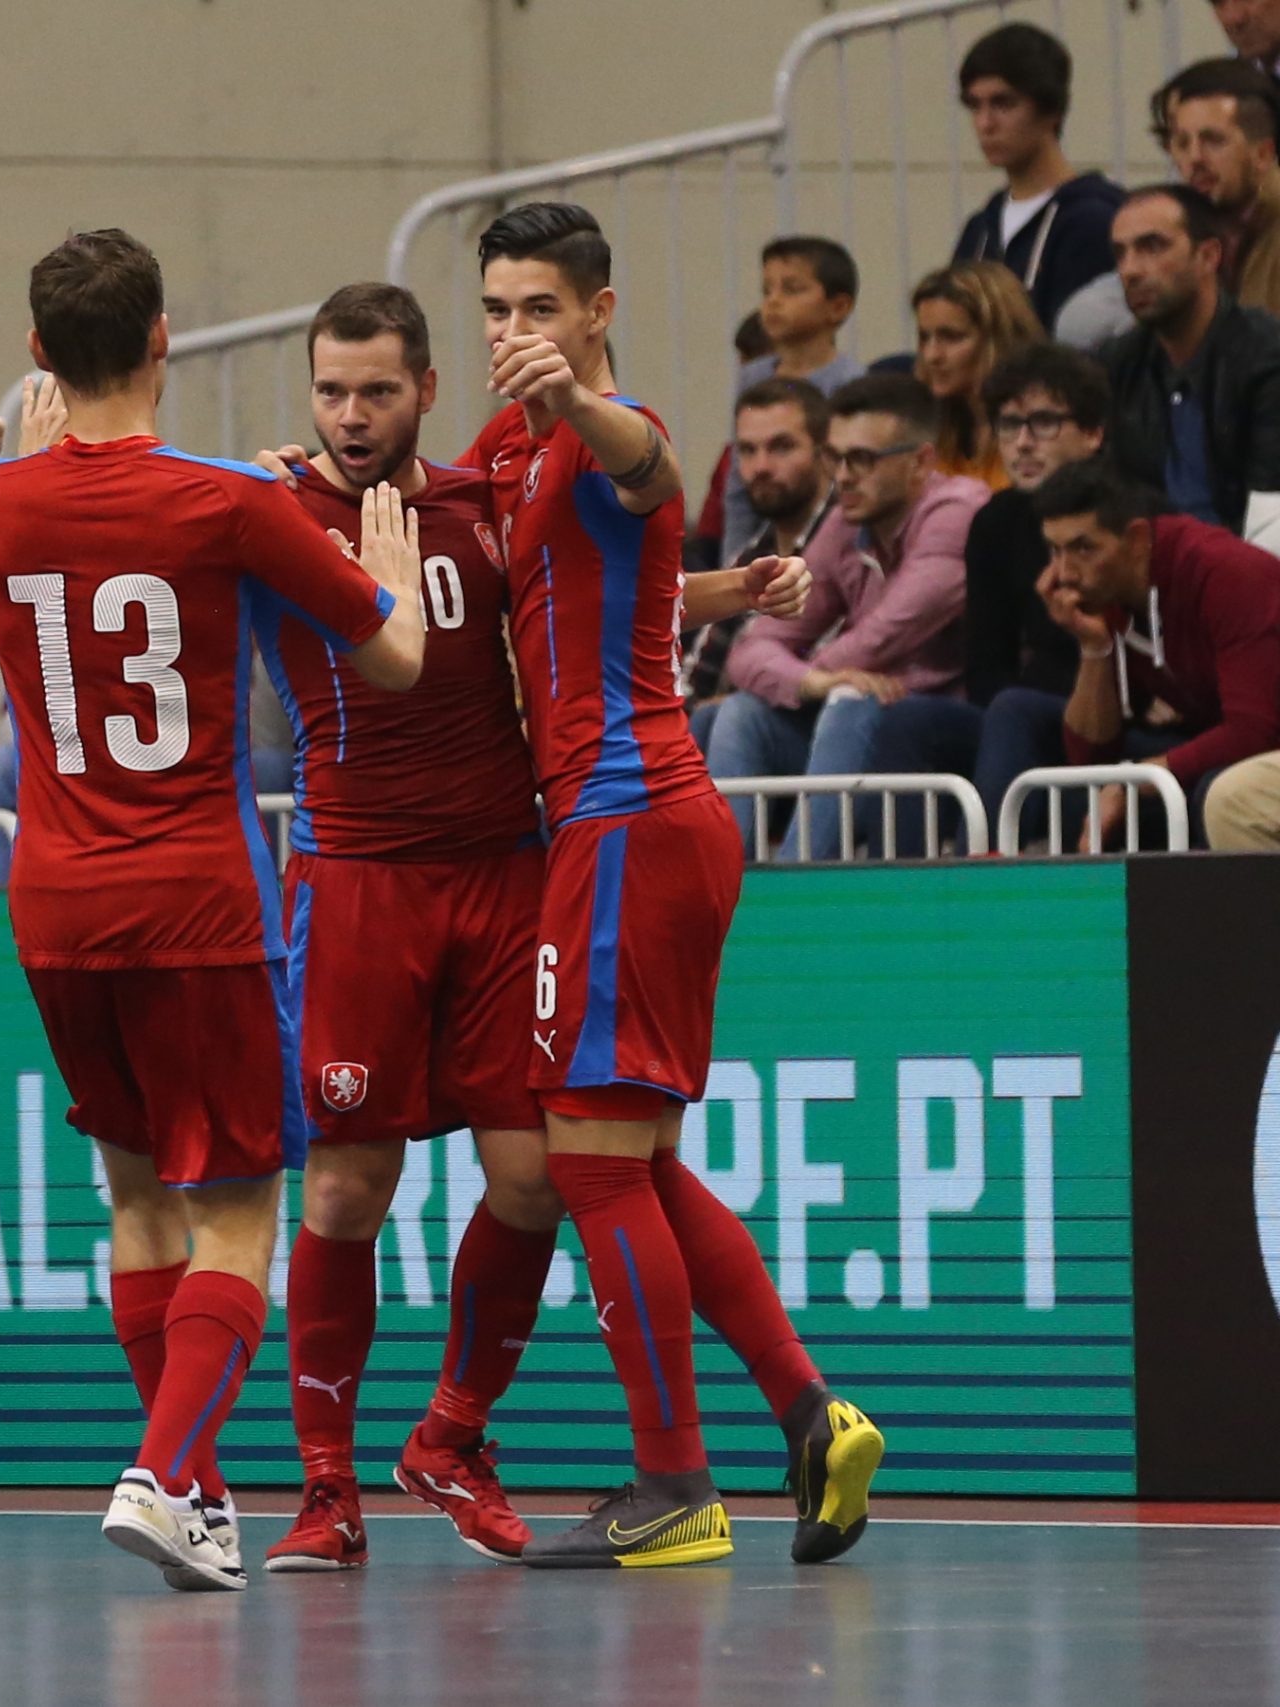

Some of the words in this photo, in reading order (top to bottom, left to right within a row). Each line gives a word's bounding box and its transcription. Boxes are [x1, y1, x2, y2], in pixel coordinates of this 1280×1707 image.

[419, 555, 465, 632] 0
[8, 573, 190, 774] 13
[535, 943, 558, 1020] 6
